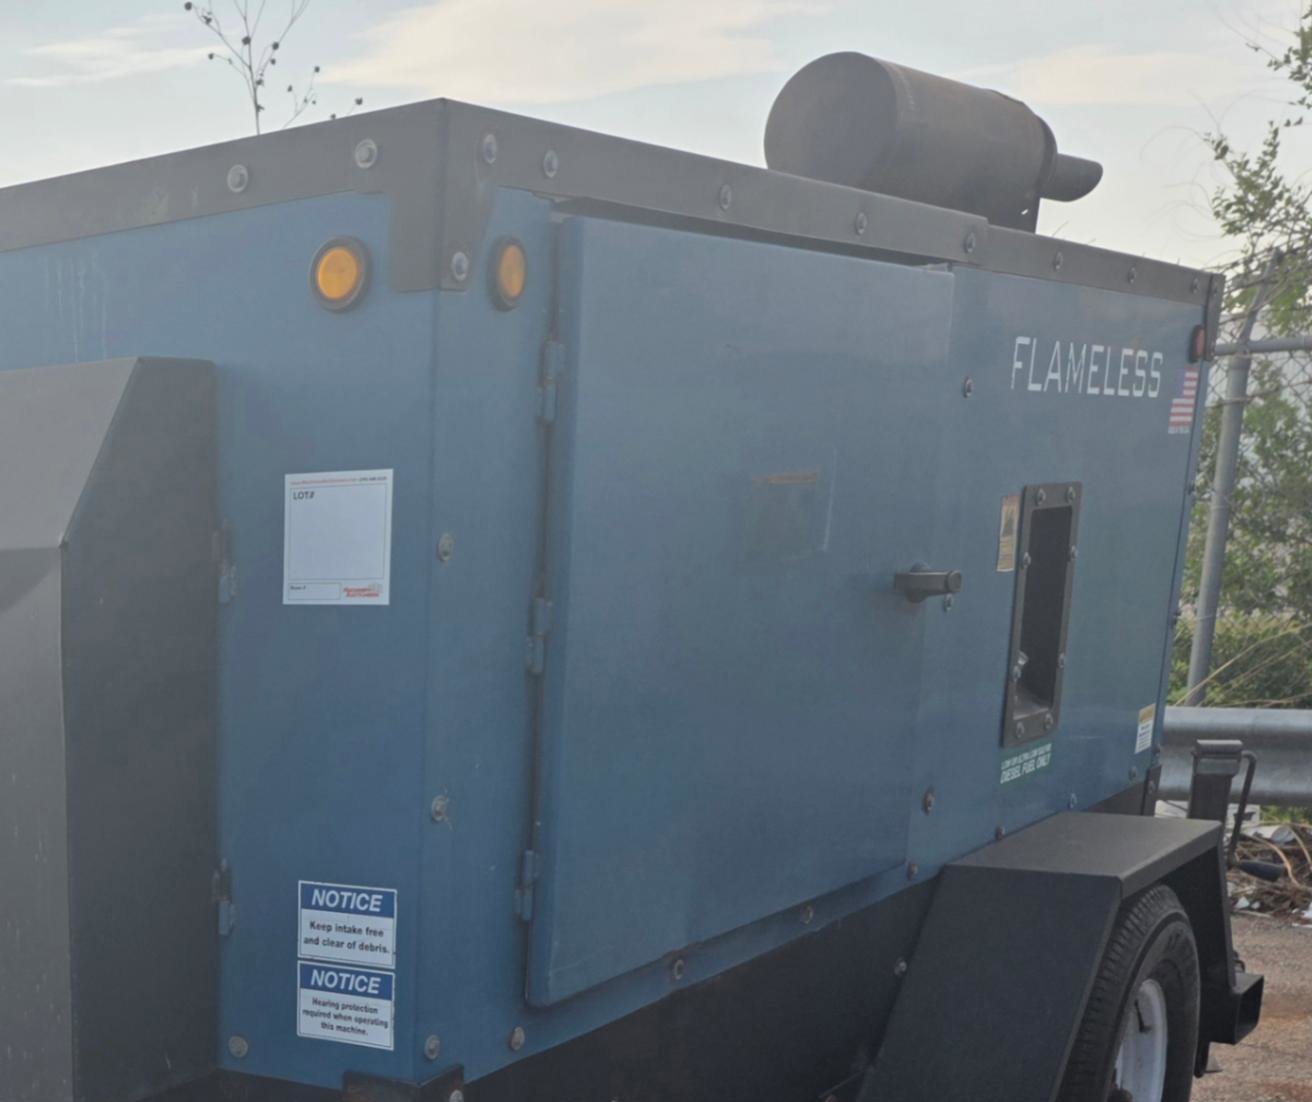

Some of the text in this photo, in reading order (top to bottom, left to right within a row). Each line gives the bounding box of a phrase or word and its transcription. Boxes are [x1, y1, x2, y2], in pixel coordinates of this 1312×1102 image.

[1011, 336, 1163, 398] FLAMELESS
[292, 491, 315, 500] LOT#
[311, 888, 383, 912] NOTICE
[309, 920, 385, 938] Keep intake free
[303, 936, 391, 954] and clear of debris.
[311, 970, 381, 994] NOTICE
[312, 997, 379, 1014] Hearing protection
[302, 1009, 388, 1029] required when operating
[320, 1022, 369, 1036] this machine.
